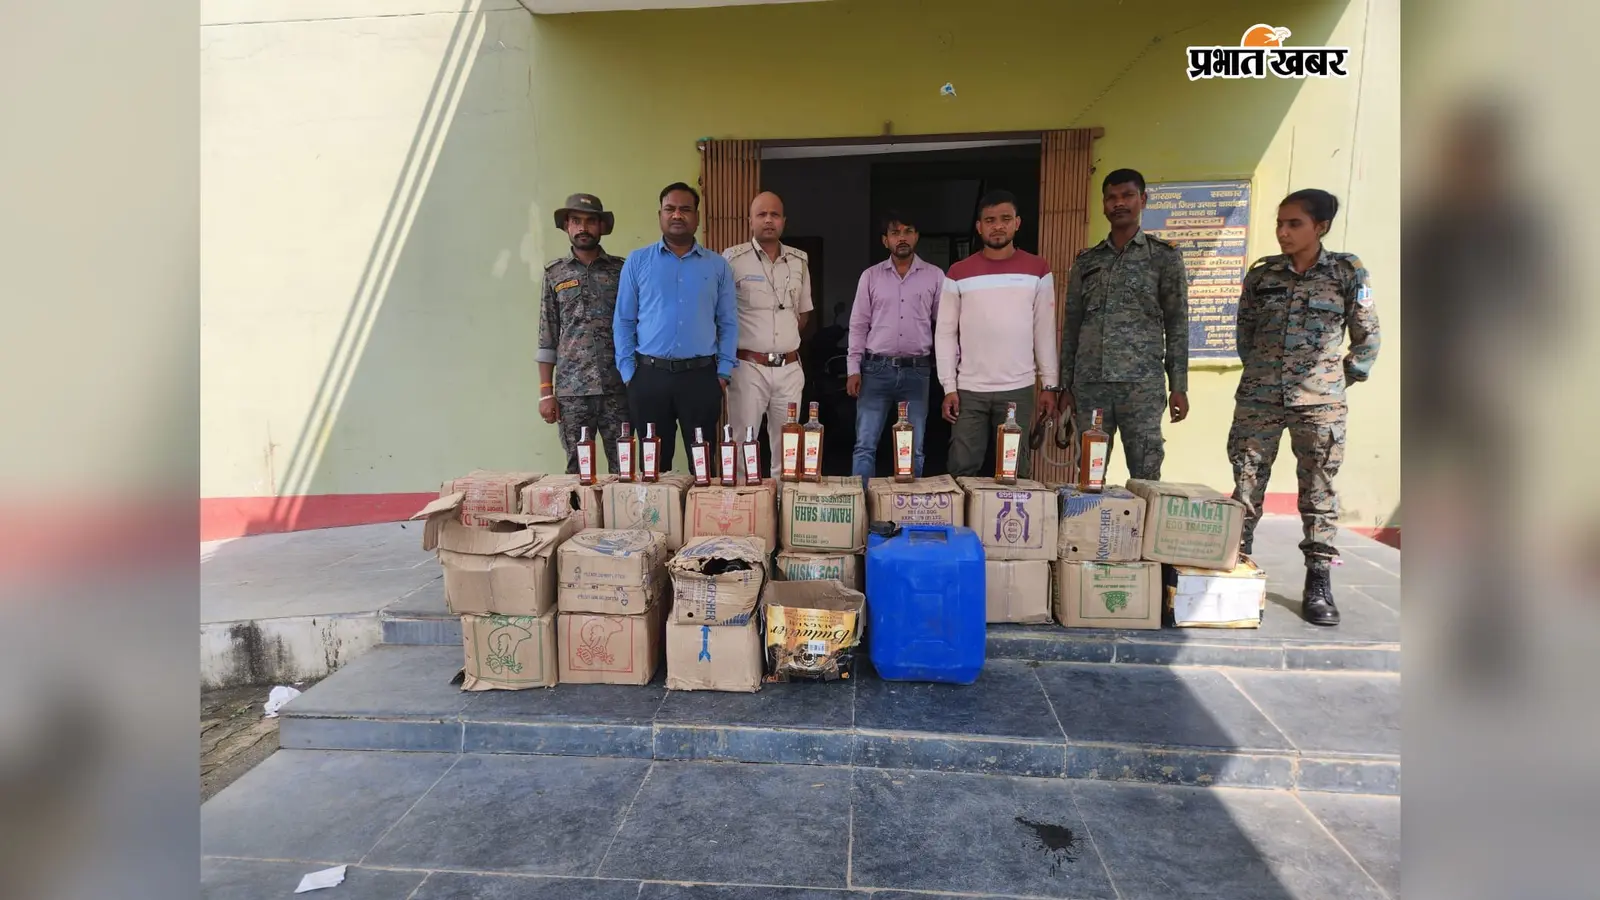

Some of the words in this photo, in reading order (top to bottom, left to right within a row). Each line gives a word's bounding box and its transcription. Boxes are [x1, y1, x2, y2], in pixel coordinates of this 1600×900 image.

[795, 506, 818, 522] SAHA
[820, 508, 852, 523] RAMAN
[1167, 496, 1223, 521] GANGA
[1095, 508, 1112, 560] KINGFISHER
